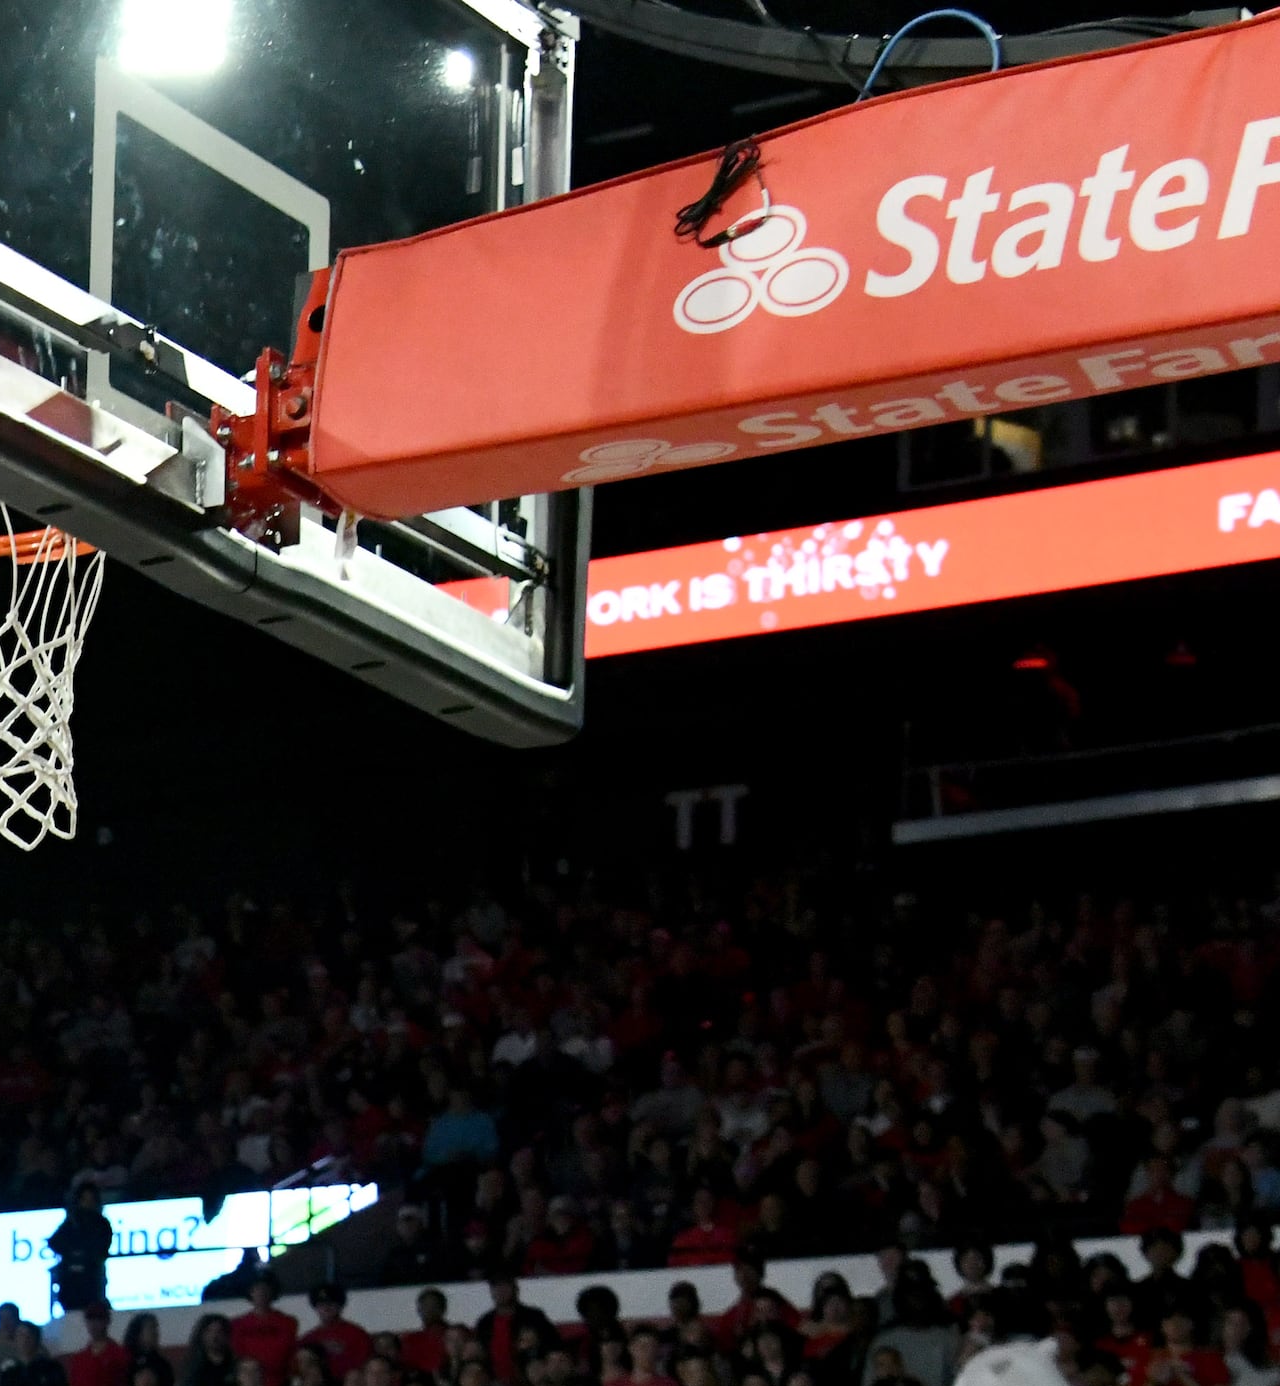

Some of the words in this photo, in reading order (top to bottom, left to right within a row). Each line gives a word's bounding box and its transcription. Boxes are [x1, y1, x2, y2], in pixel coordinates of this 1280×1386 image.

[864, 144, 1210, 298] State
[738, 373, 1072, 449] State
[688, 572, 734, 612] IS
[742, 537, 950, 603] THIRSTY
[12, 1215, 201, 1261] baing?
